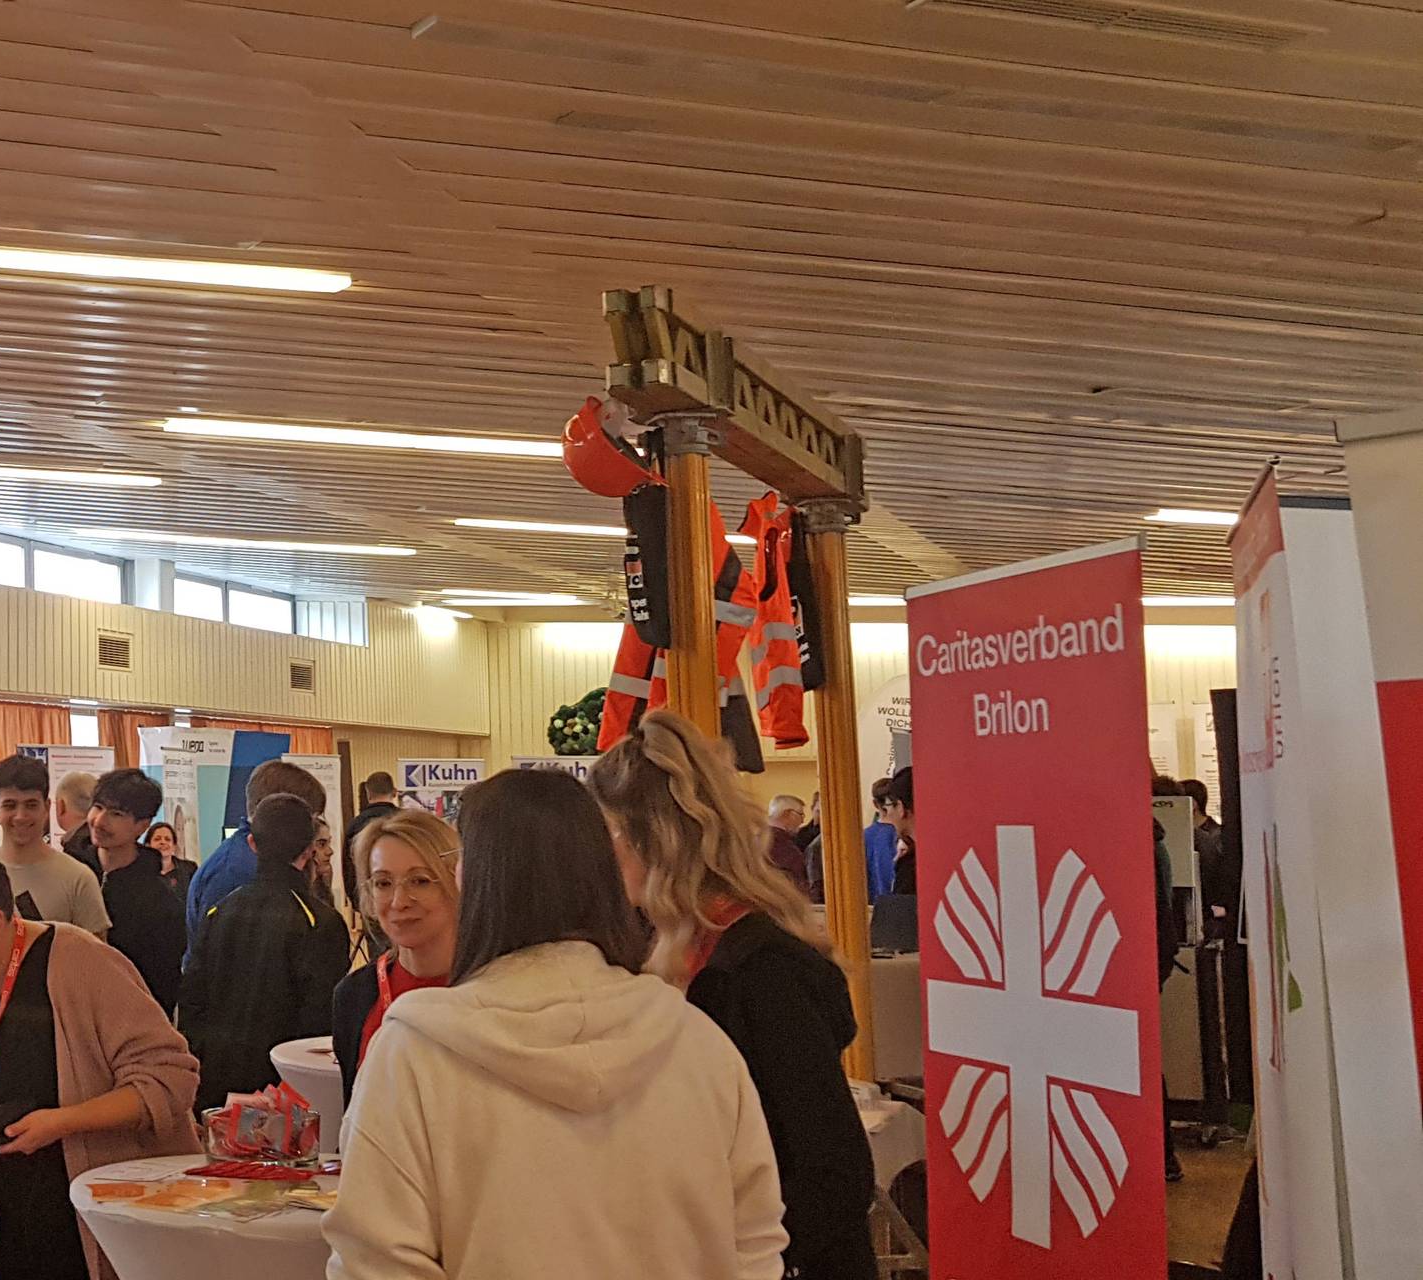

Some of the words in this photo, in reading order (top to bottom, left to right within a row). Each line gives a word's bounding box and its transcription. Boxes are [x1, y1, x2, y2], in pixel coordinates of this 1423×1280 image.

[916, 603, 1125, 677] Caritasverband
[878, 707, 911, 717] WOLL
[973, 690, 1050, 737] Brilon
[428, 764, 477, 780] Kuhn
